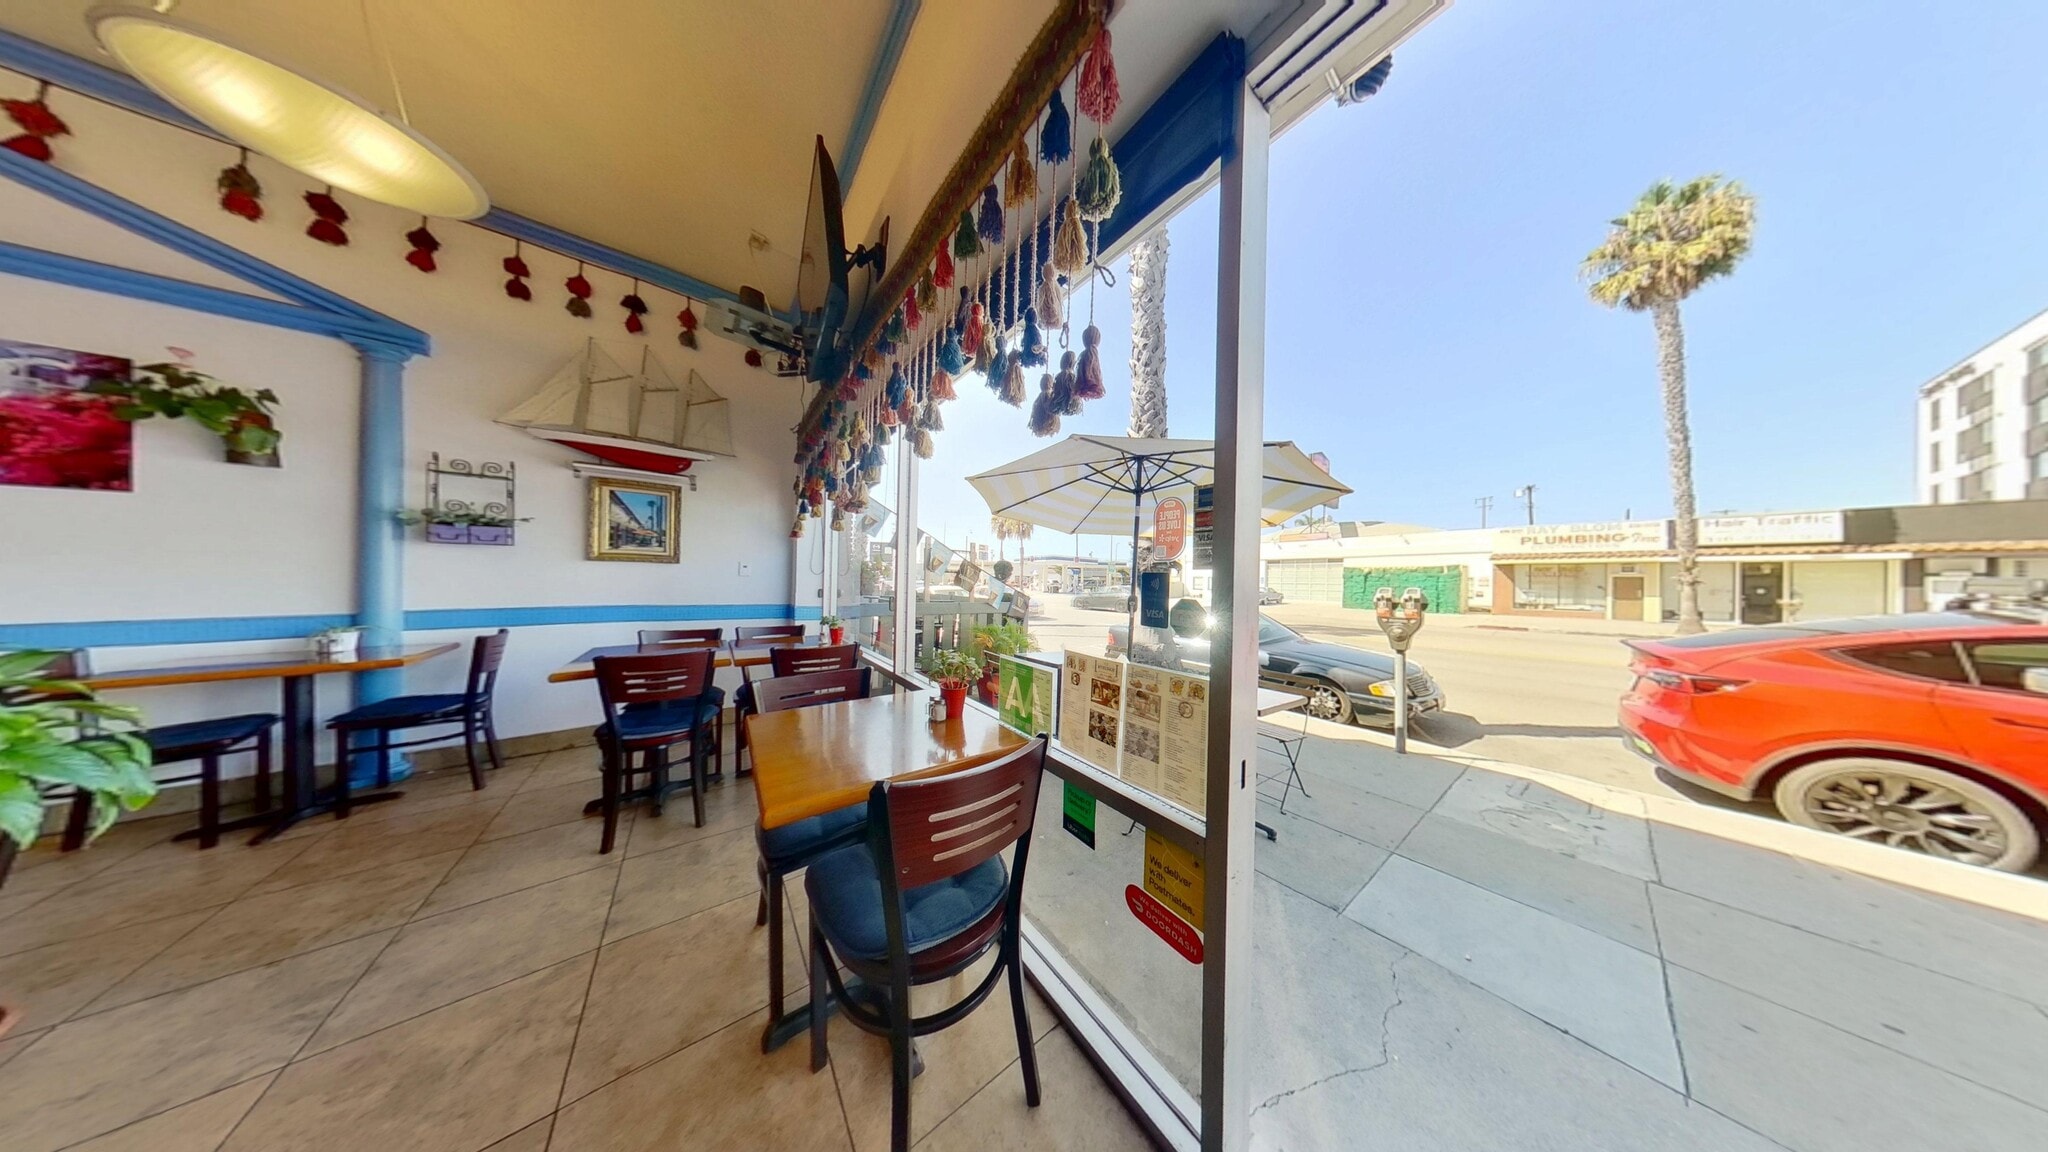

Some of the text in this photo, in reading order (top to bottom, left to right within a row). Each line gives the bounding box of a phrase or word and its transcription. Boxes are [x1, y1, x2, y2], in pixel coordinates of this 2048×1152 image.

[1520, 533, 1630, 546] PLUMBING
[1146, 609, 1165, 619] VISA
[1149, 854, 1193, 889] We deliver
[1149, 868, 1166, 884] with
[1149, 877, 1196, 917] Postmates.
[1139, 895, 1188, 937] We deliver with
[1145, 910, 1198, 956] DOORDASH
